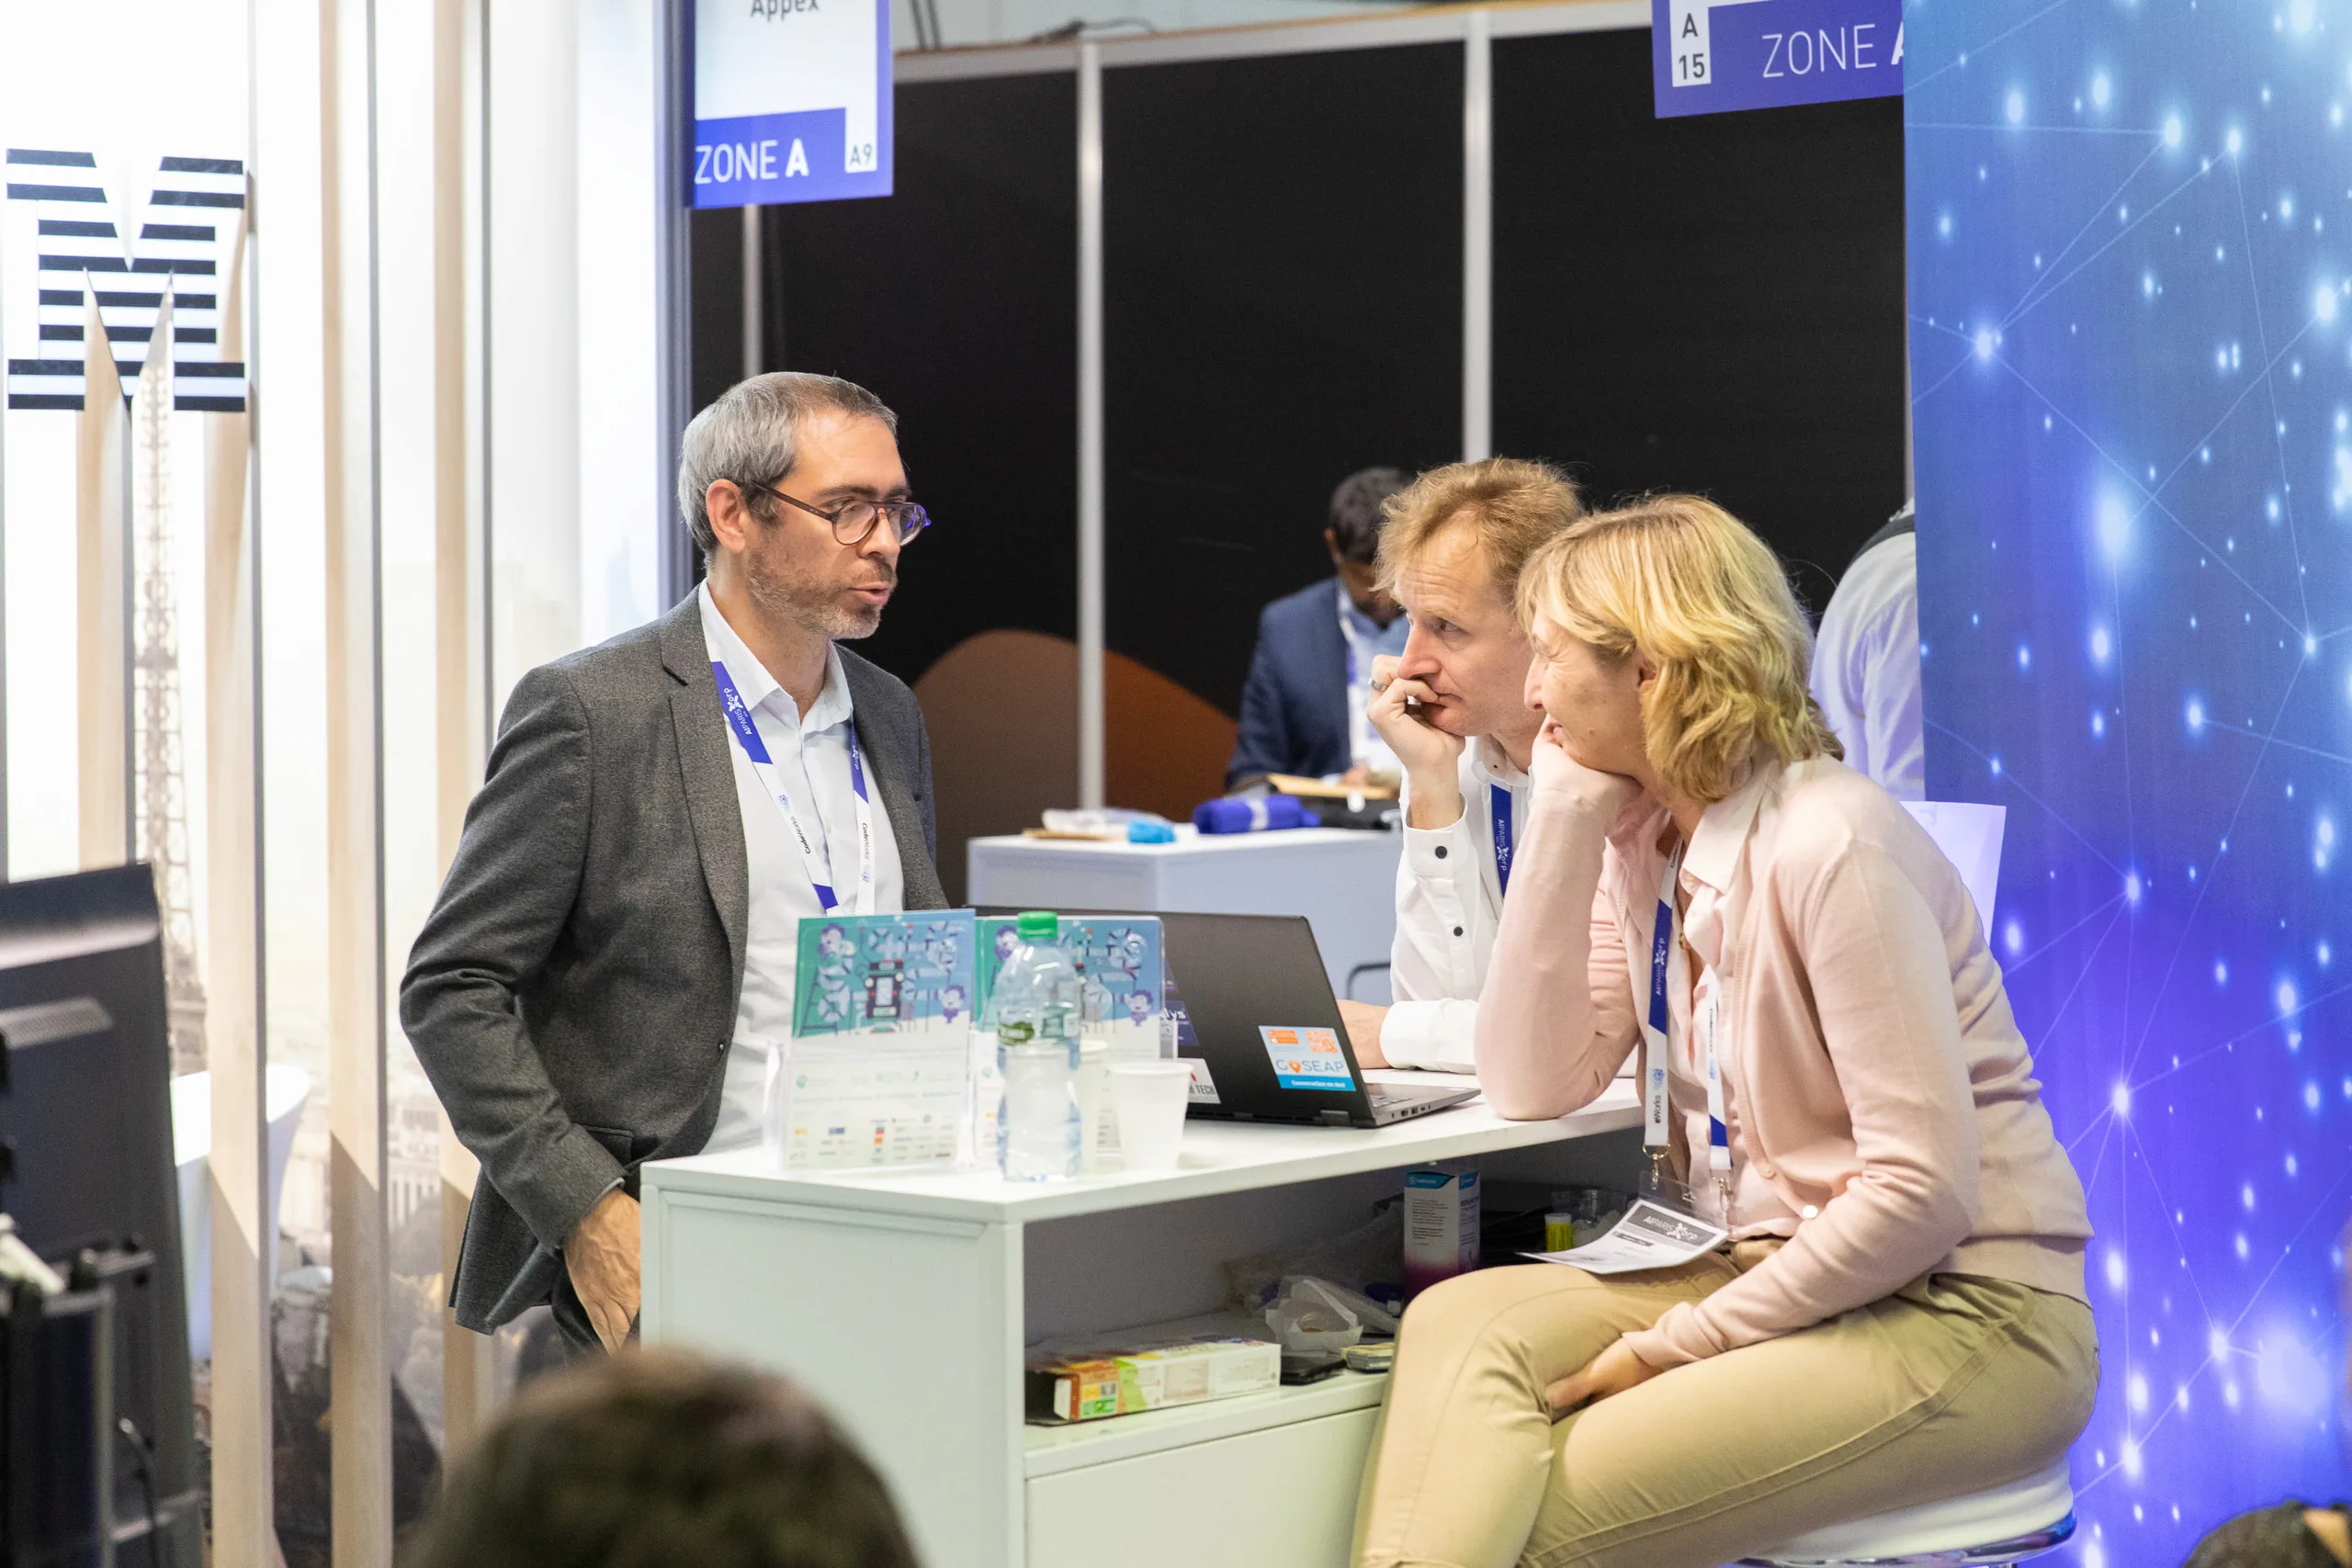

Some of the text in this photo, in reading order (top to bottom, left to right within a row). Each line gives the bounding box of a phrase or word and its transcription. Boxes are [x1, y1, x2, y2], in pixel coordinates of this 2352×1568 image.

[1682, 13, 1699, 39] A
[1761, 23, 1878, 78] ZONE
[1679, 53, 1705, 80] 15
[695, 138, 810, 185] ZONE A
[849, 143, 873, 166] A9
